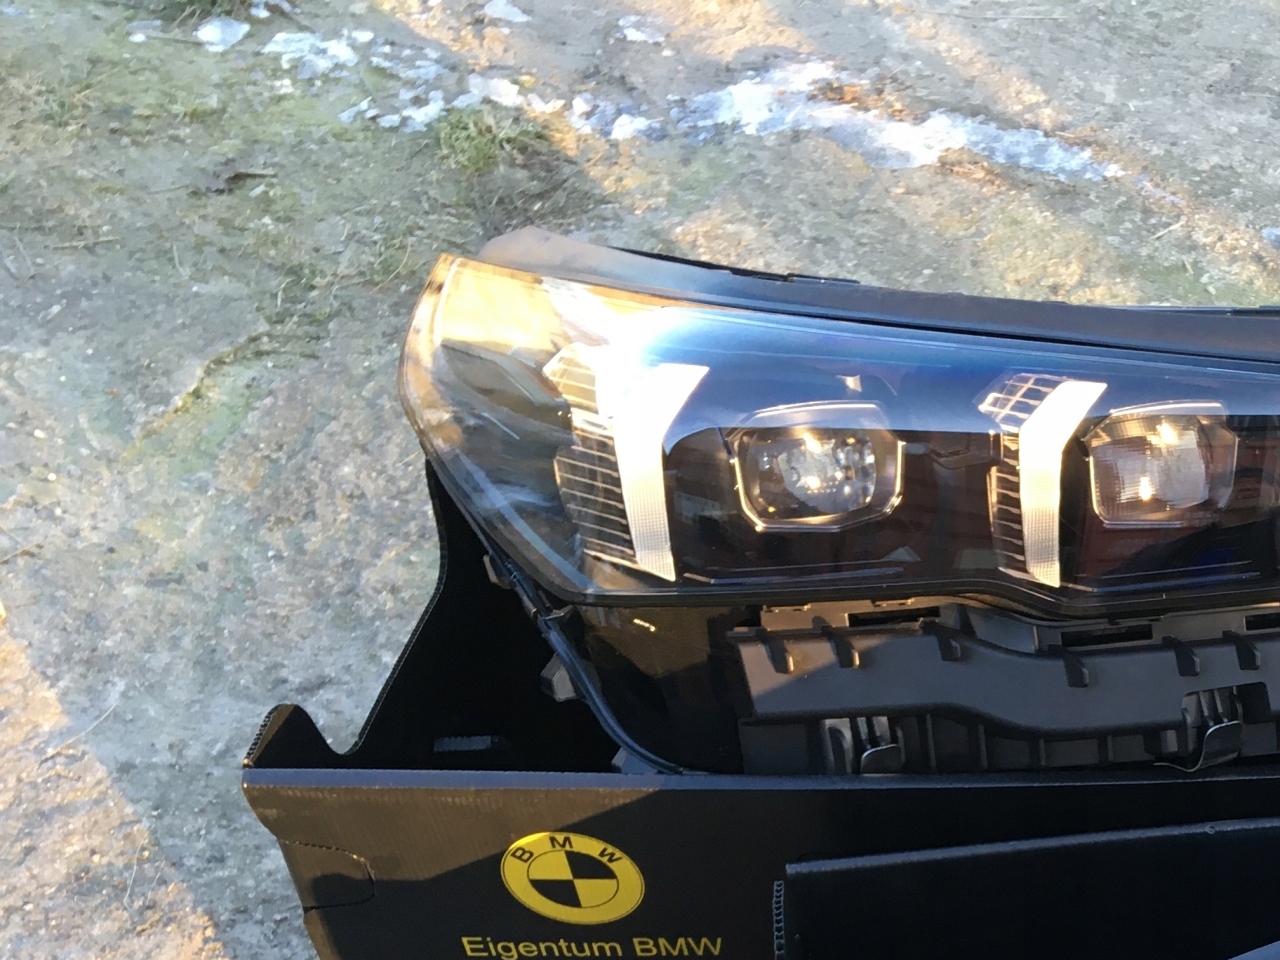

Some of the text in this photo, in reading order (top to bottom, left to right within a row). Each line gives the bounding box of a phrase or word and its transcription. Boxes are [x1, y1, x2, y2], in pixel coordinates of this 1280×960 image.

[510, 835, 624, 864] BMW
[461, 936, 722, 960] Eigentum BMW
